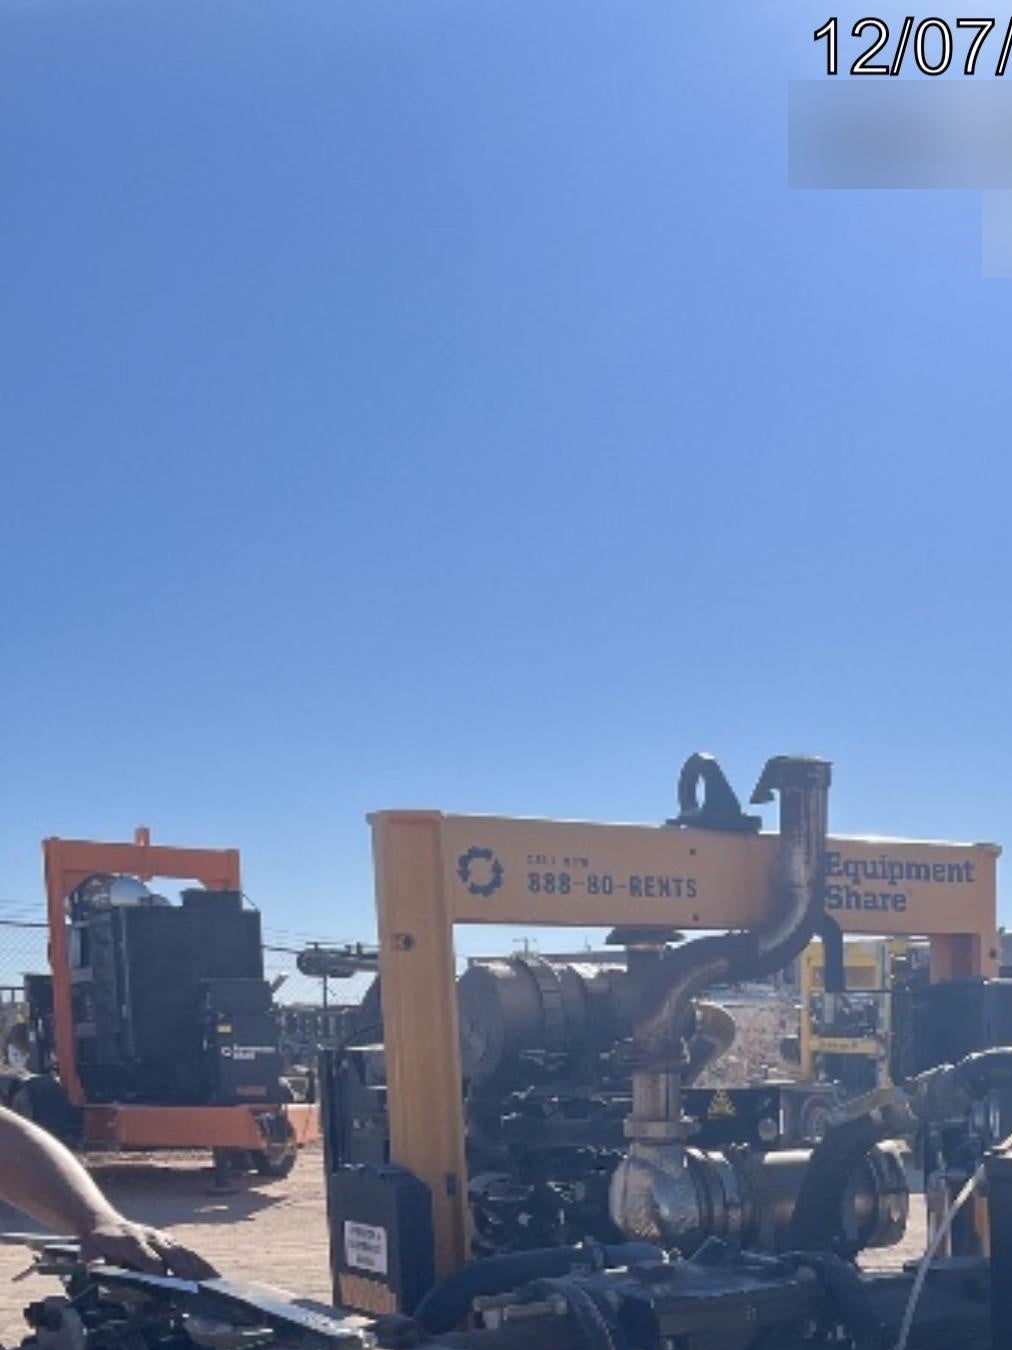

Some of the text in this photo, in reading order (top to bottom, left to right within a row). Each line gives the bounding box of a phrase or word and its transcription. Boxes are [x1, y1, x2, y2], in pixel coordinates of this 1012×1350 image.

[826, 851, 976, 886] Equipment
[527, 872, 697, 899] 888-80-RENTS
[827, 884, 908, 912] Share
